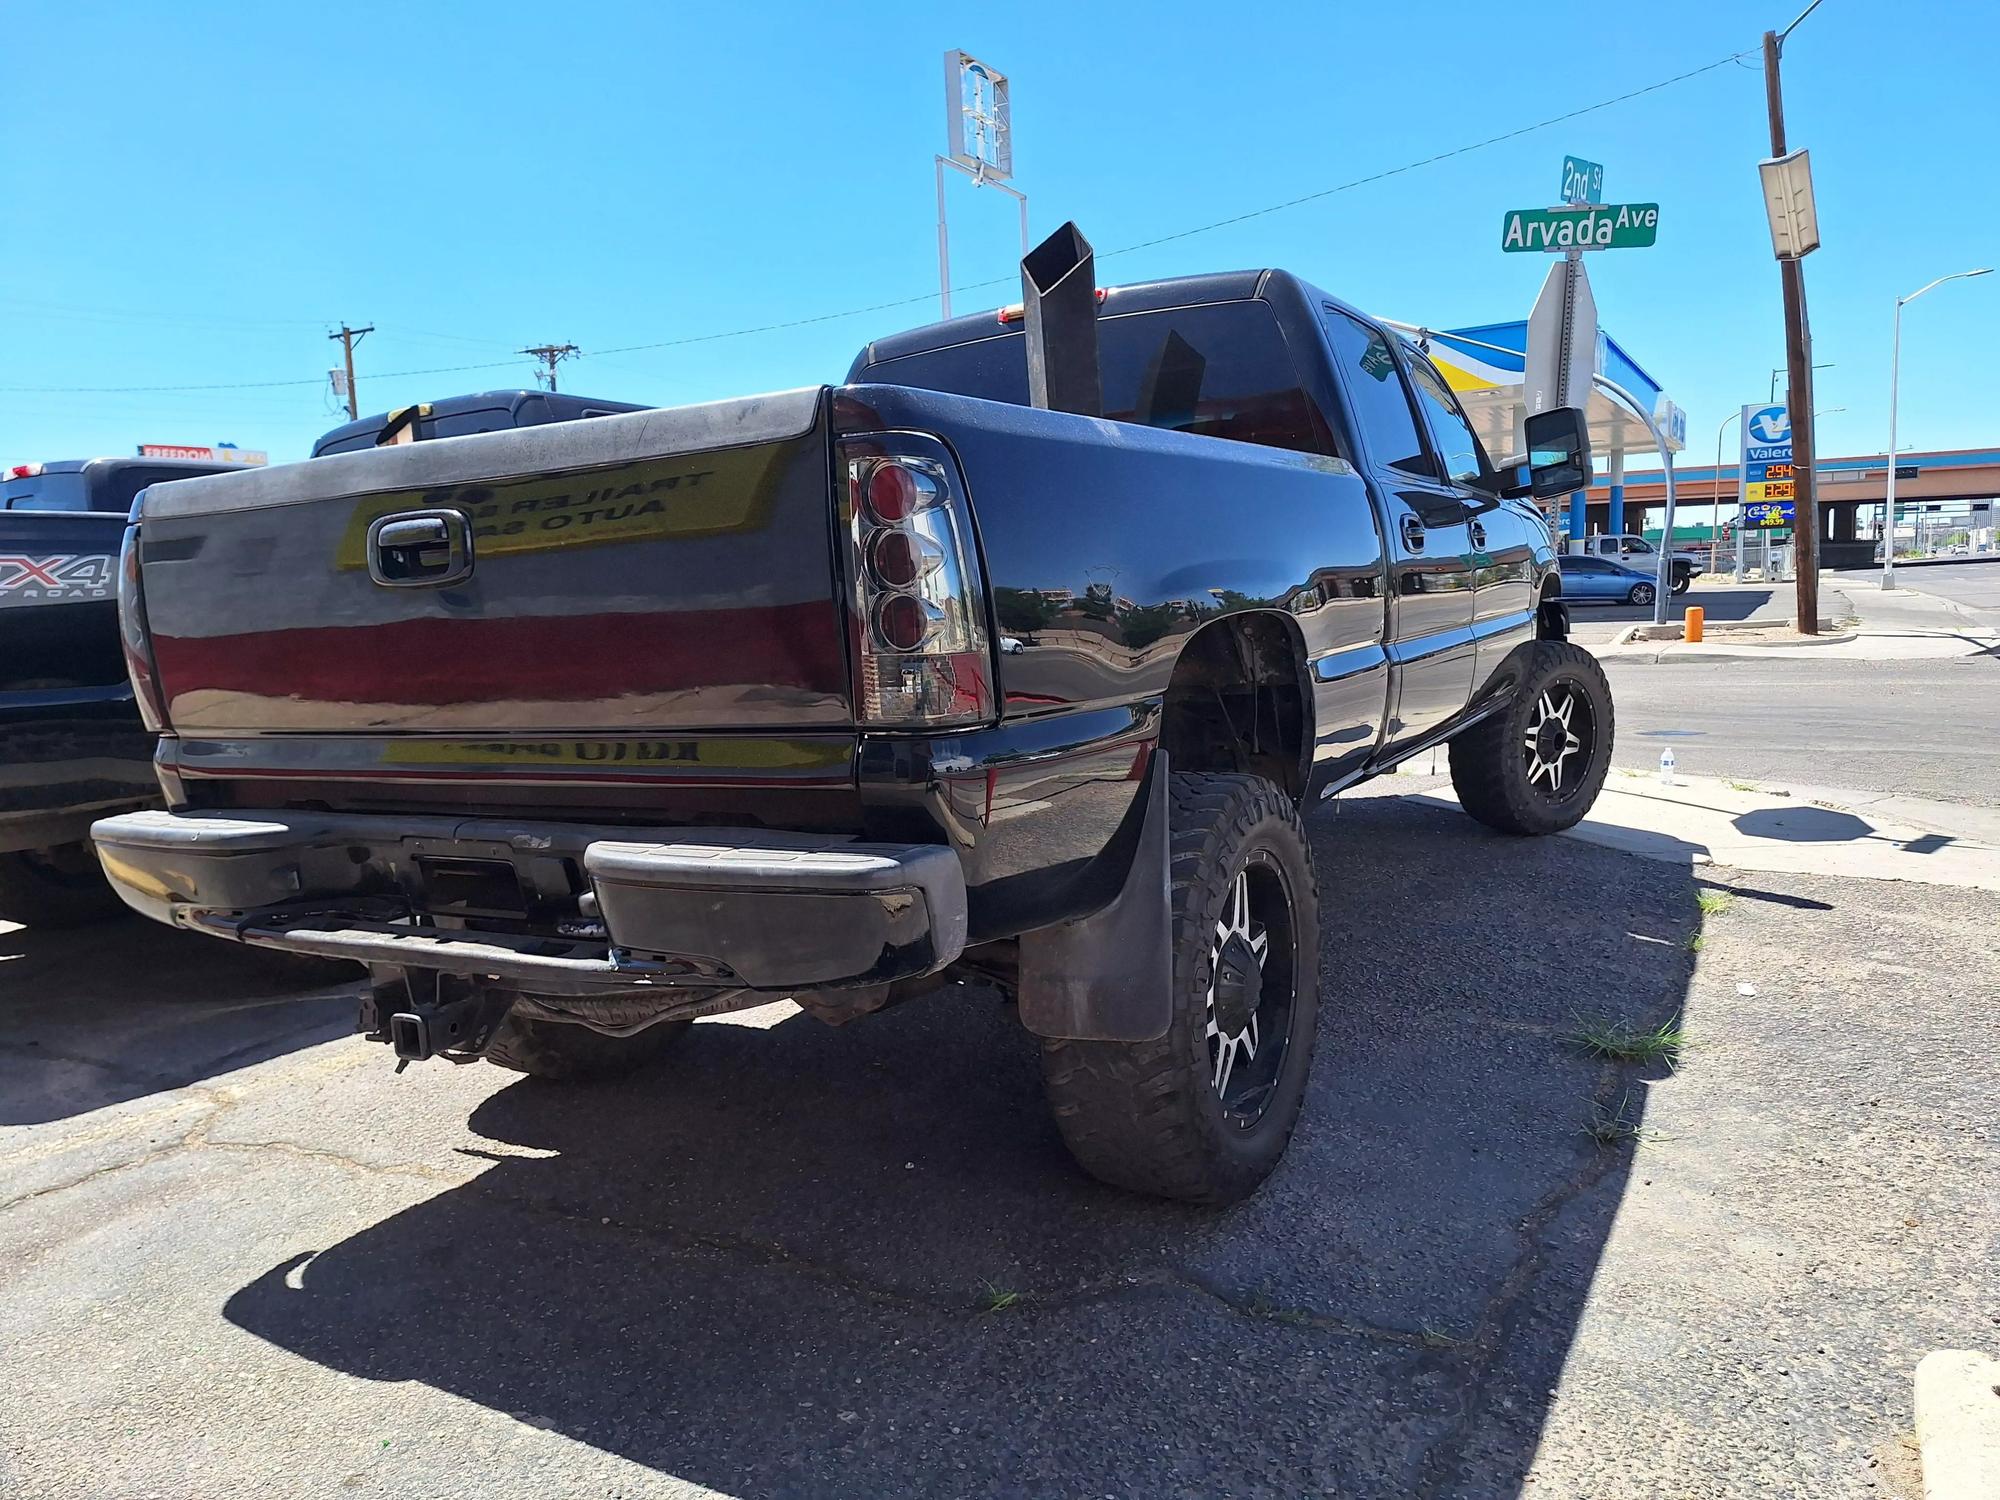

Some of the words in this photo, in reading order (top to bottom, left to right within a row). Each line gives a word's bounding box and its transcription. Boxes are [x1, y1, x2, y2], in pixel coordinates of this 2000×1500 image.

[1563, 161, 1589, 200] 2nd
[1593, 167, 1602, 190] St
[1504, 210, 1614, 249] Arvada
[1615, 205, 1658, 229] Ave
[143, 447, 213, 461] FREEDOM
[1766, 464, 1793, 479] 2.94
[0, 554, 112, 589] X4
[23, 588, 107, 598] ROAD
